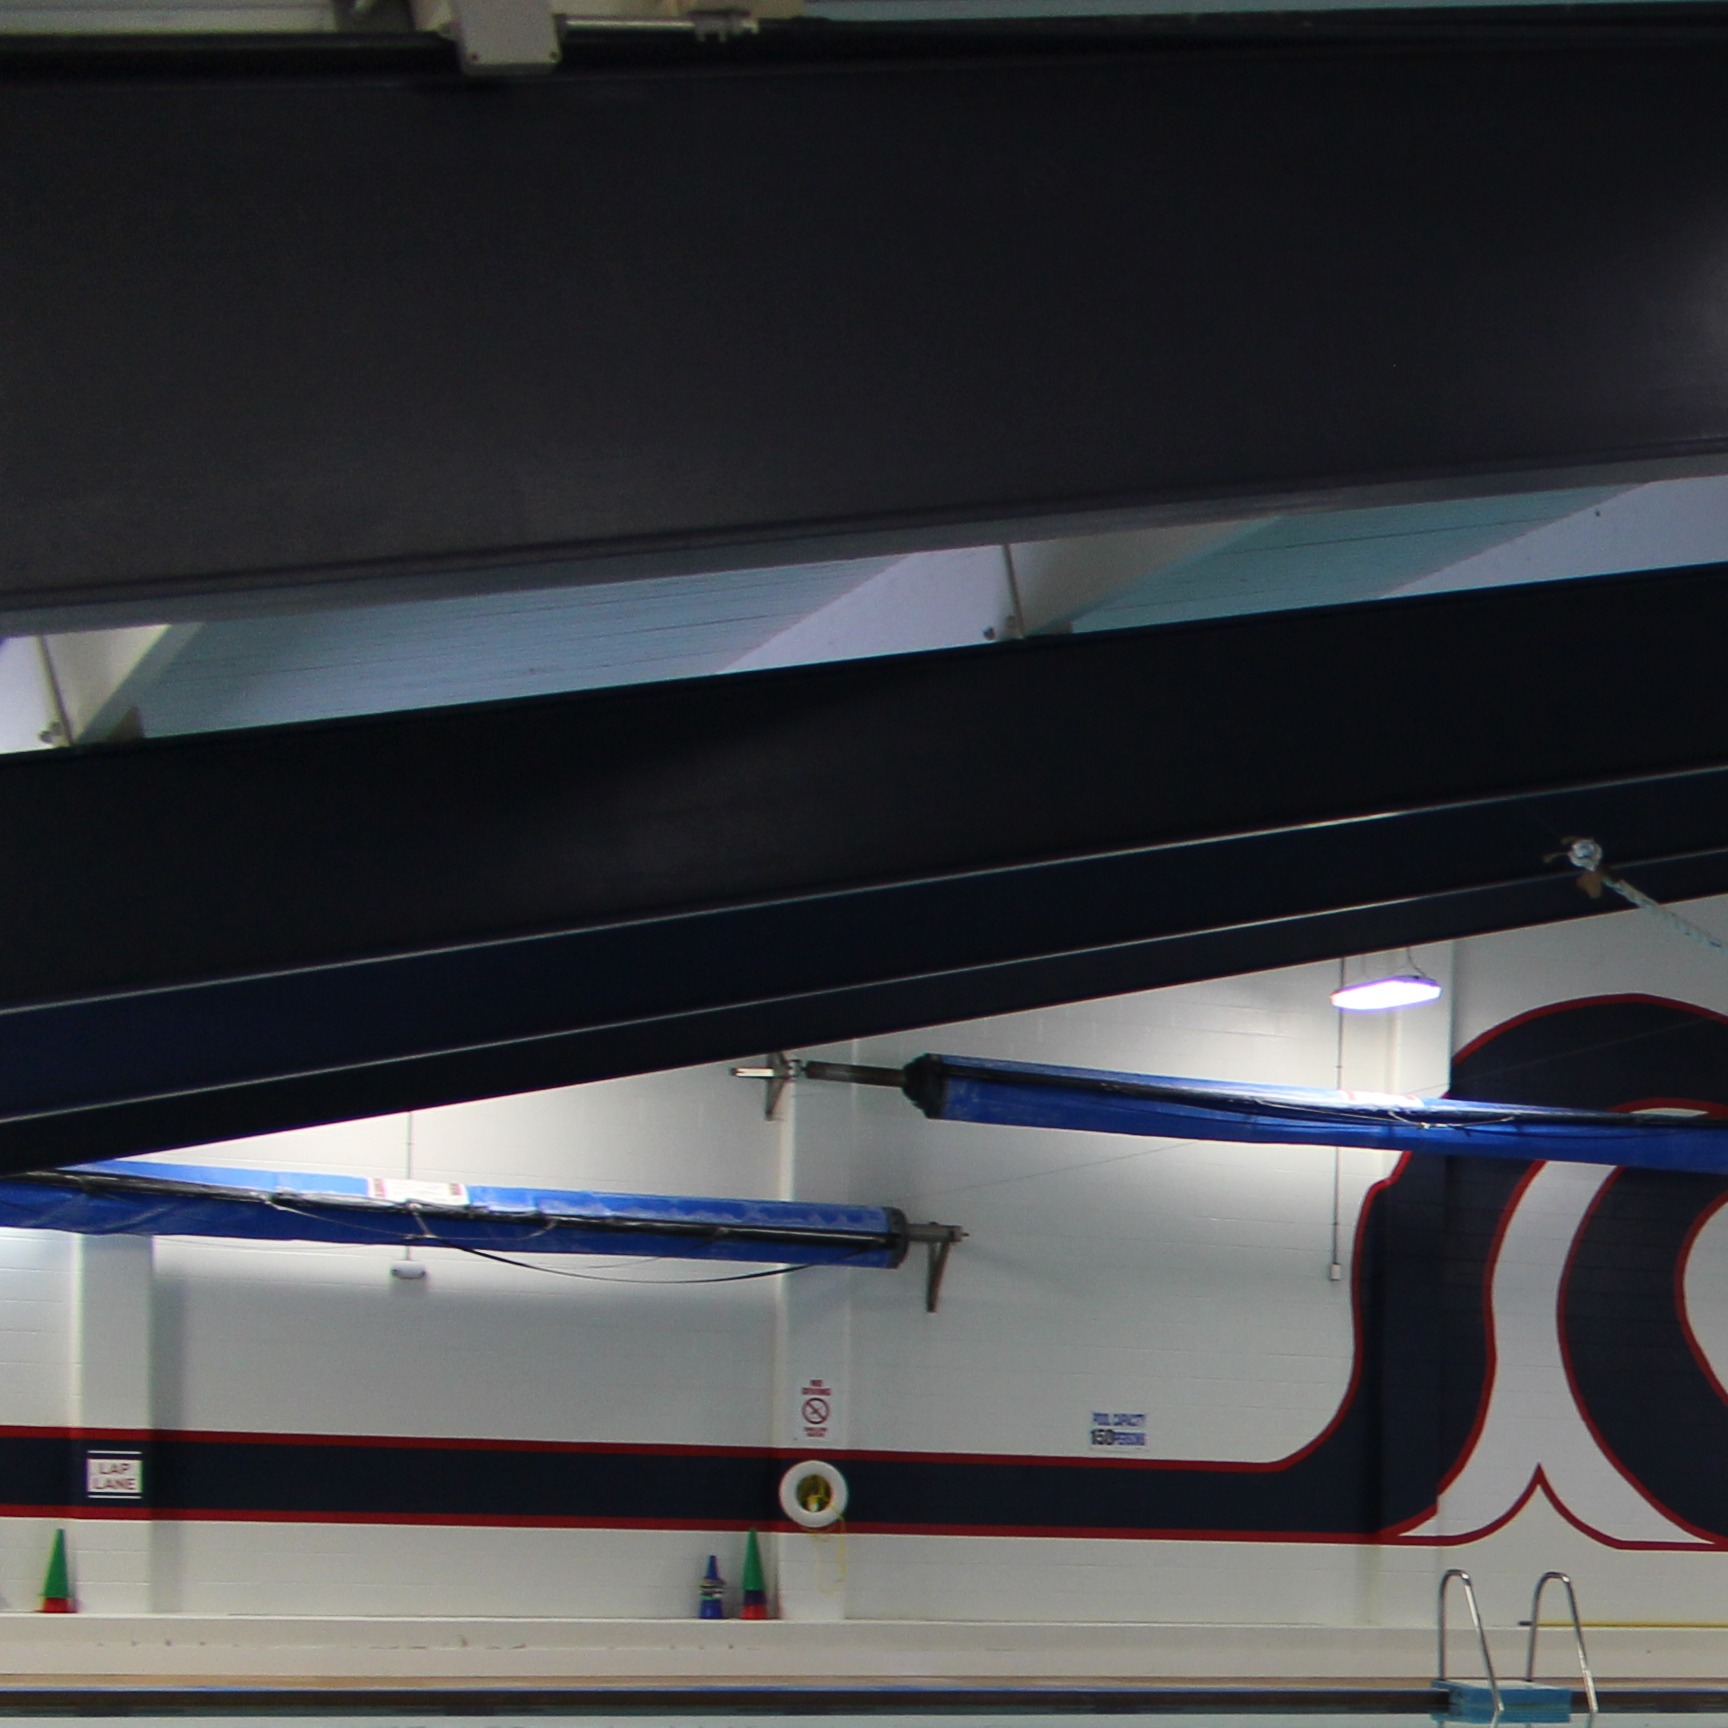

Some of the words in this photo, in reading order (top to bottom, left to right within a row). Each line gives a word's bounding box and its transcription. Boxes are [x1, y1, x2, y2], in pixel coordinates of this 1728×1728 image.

[1091, 1429, 1114, 1445] 150
[100, 1462, 130, 1475] LAP
[93, 1477, 135, 1490] LANE
